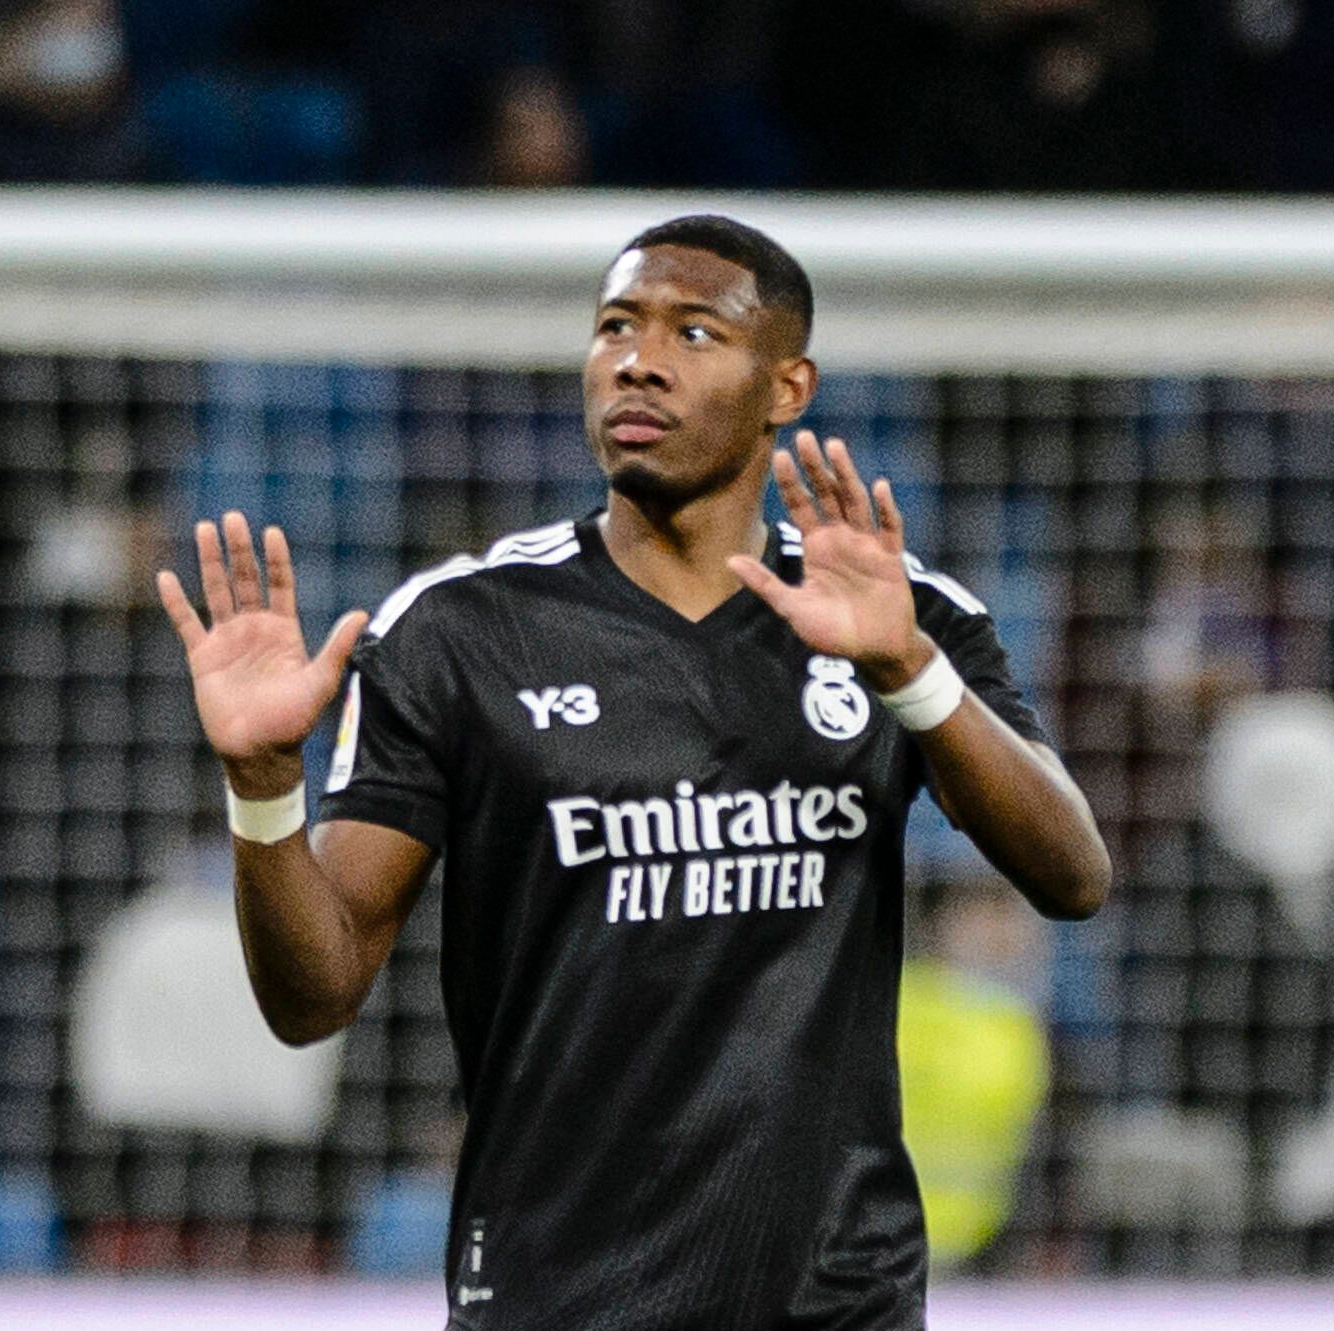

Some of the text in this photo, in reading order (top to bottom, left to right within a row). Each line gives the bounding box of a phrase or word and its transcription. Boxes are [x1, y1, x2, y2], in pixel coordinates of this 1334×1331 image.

[516, 683, 602, 731] Y-3
[546, 779, 869, 868] Emirates
[605, 851, 827, 924] FLY BETTER
